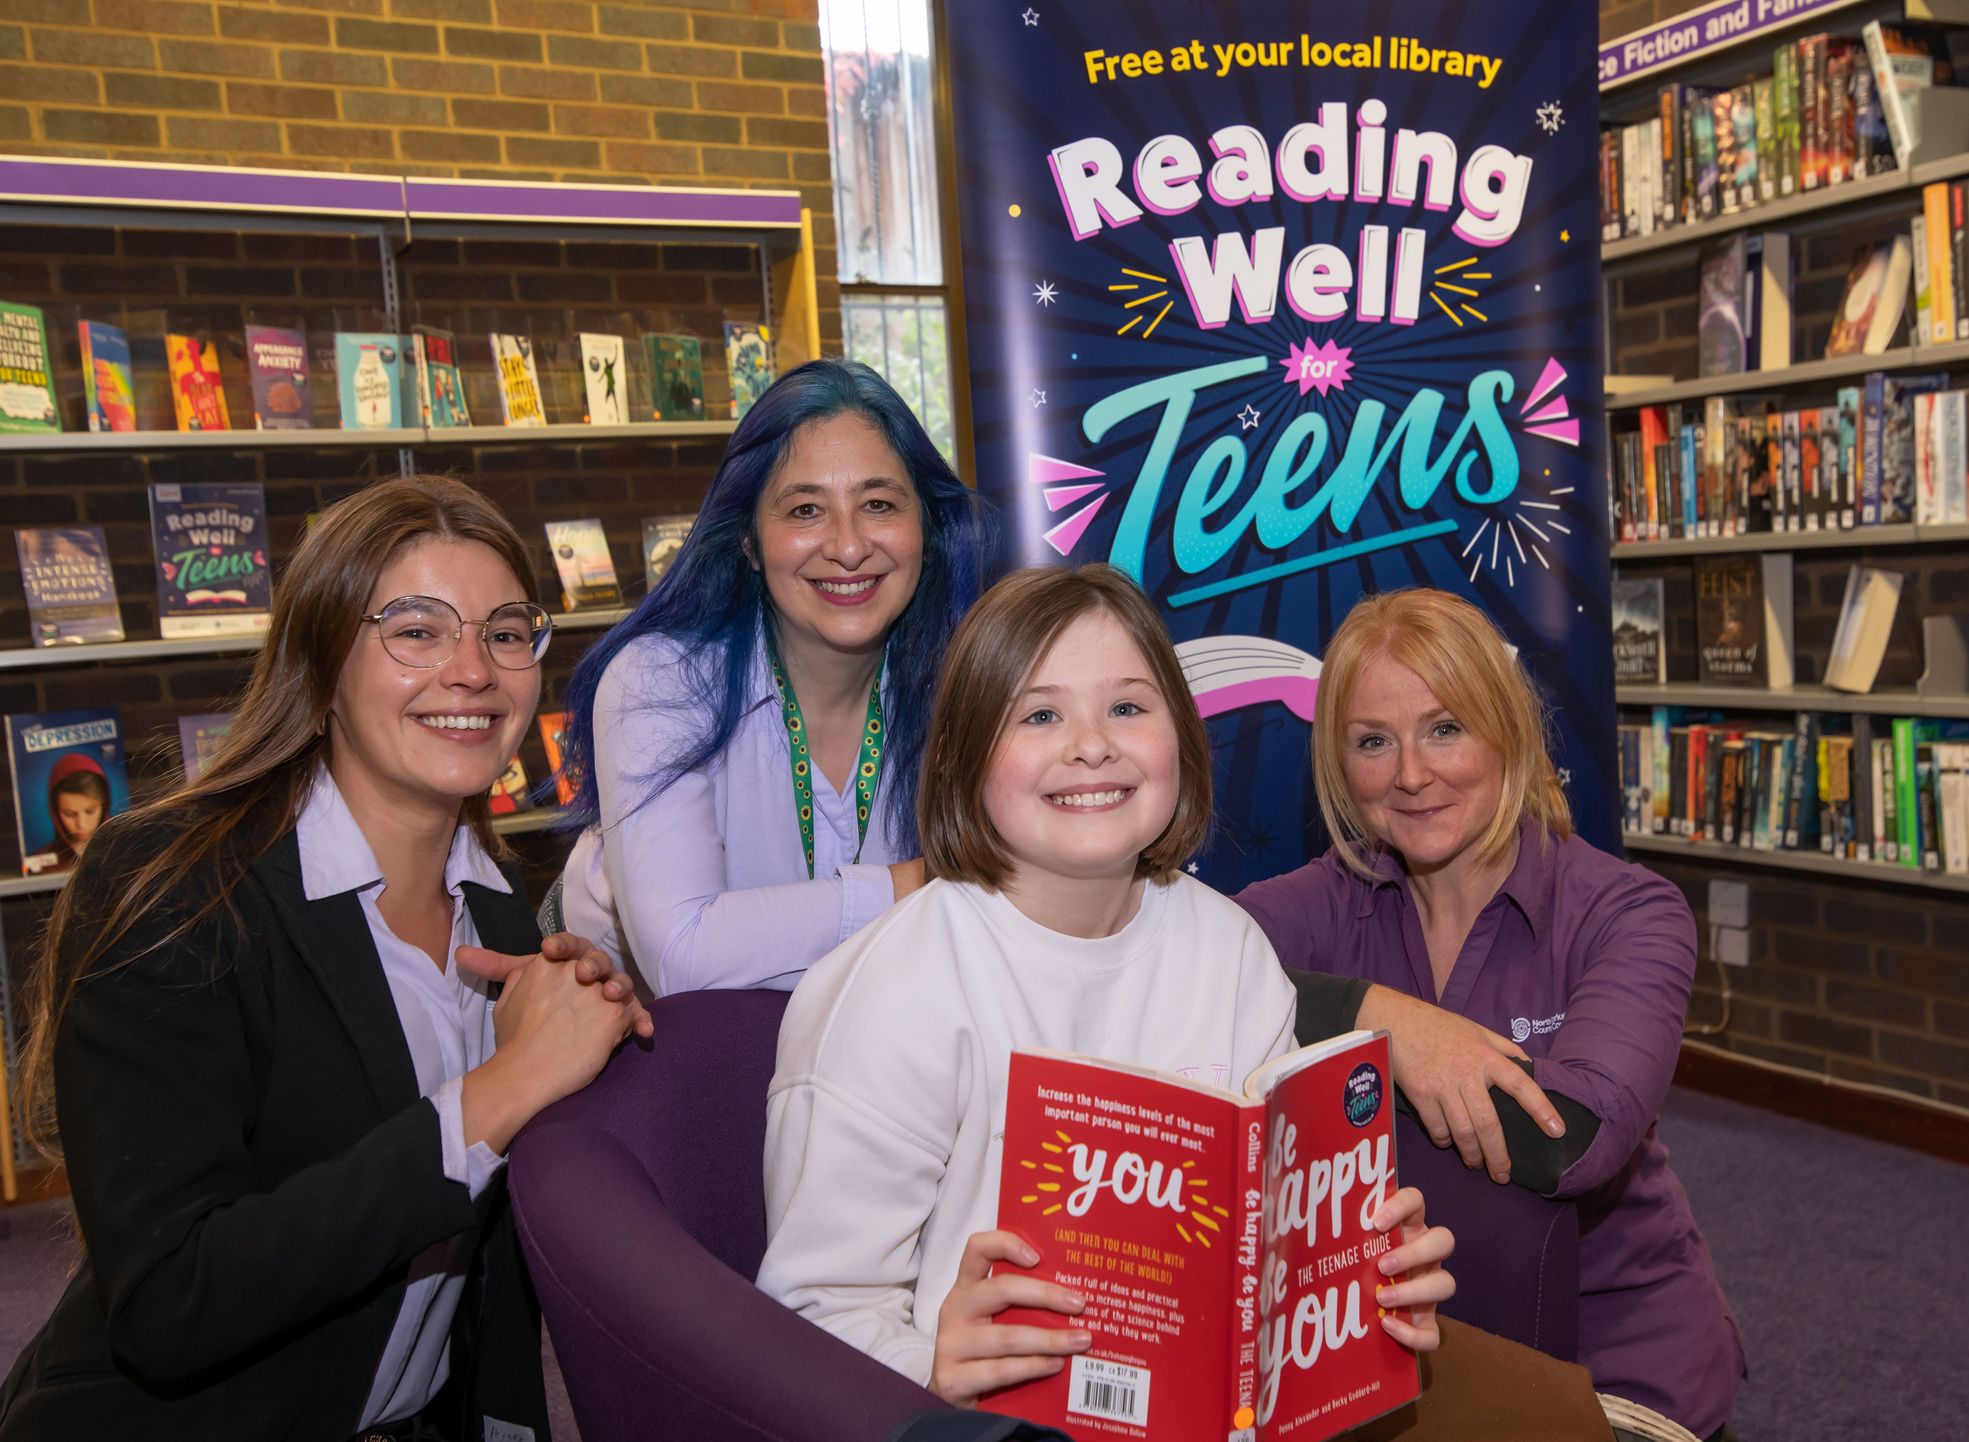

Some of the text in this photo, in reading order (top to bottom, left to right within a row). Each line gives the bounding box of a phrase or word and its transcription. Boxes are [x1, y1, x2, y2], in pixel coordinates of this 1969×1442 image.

[1624, 26, 1698, 71] Fiction
[1706, 1, 1749, 41] and
[1084, 34, 1502, 88] Free at your local library
[1047, 99, 1533, 247] Reading
[1168, 224, 1426, 330] Well
[258, 356, 302, 371] ANXIETY
[1299, 354, 1338, 379] for
[1082, 355, 1520, 587] Teens
[166, 509, 255, 533] Reading
[188, 528, 236, 547] Well
[172, 547, 254, 591] Teens
[1348, 1070, 1376, 1090] Reading
[1355, 1081, 1370, 1095] Well
[1037, 1085, 1215, 1139] Increase the happiness levels of the most
[1045, 1105, 1090, 1124] important
[1092, 1114, 1122, 1133] person
[1125, 1121, 1141, 1135] you
[1144, 1126, 1159, 1140] will
[1161, 1131, 1179, 1145] ever
[1247, 1122, 1261, 1173] Collins
[1067, 1143, 1186, 1217] you
[1055, 1228, 1185, 1270] (AND THEN YOU CAN DEAL WITH
[1238, 1211, 1262, 1269] happy
[1297, 1232, 1392, 1288] THE TEENAGE GUIDE
[1066, 1248, 1081, 1265] THE
[1106, 1256, 1117, 1272] OF
[1120, 1259, 1134, 1276] THE
[1055, 1271, 1179, 1310] Packed full of ideas and practical
[1085, 1291, 1095, 1303] to
[1096, 1293, 1127, 1310] increase
[1169, 1310, 1185, 1325] plus
[1069, 1315, 1085, 1328] how
[1088, 1319, 1102, 1332] and
[1103, 1322, 1119, 1337] why
[1121, 1325, 1139, 1341] they
[1101, 1308, 1110, 1319] of
[1112, 1310, 1125, 1323] the
[1127, 1314, 1154, 1330] science
[1156, 1318, 1180, 1337] behind
[1236, 1295, 1255, 1333] you
[1257, 1279, 1369, 1427] you
[1239, 1341, 1255, 1409] THE TEENA
[1278, 1421, 1294, 1437] Penny
[1295, 1407, 1320, 1428] Alexander
[1321, 1401, 1331, 1414] and
